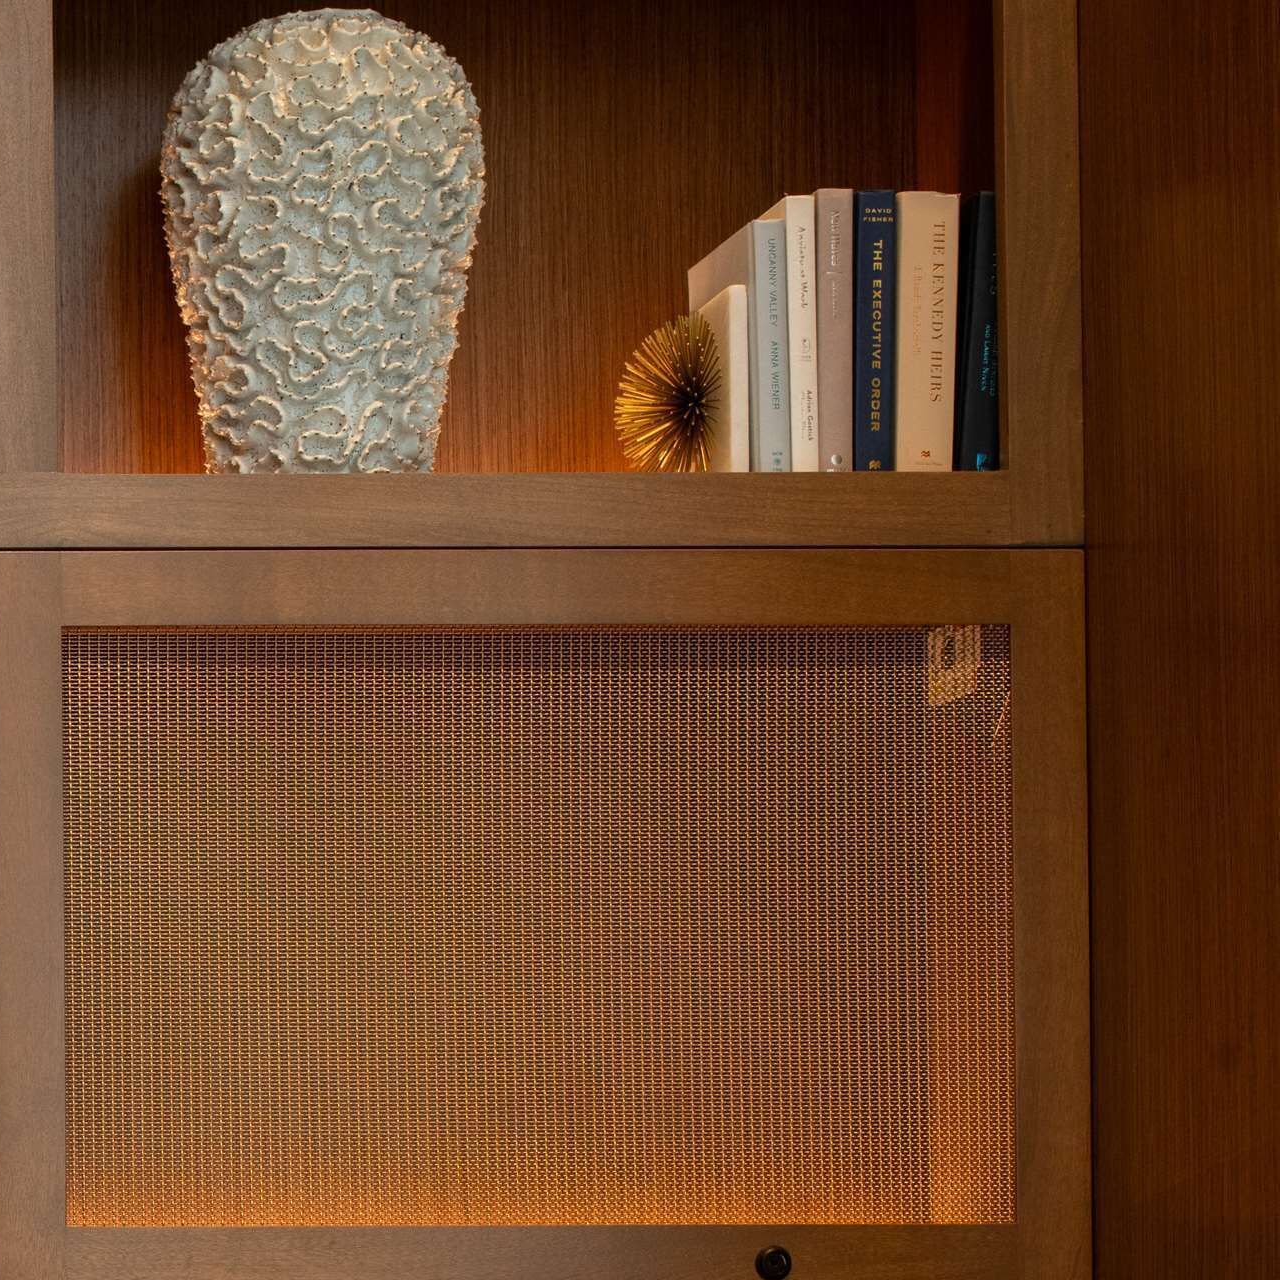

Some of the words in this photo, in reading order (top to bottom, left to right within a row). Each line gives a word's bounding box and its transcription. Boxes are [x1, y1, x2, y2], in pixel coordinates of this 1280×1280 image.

[873, 240, 883, 271] THE
[932, 221, 946, 256] THE
[767, 238, 778, 287] UNCANNY
[769, 289, 778, 327] VALLEY
[872, 279, 882, 369] EXECUTIVE
[931, 263, 945, 341] KENNEDY
[769, 340, 780, 368] ANNA
[771, 371, 780, 410] WIENER
[929, 351, 943, 403] HEIRS
[871, 377, 881, 432] ORDER
